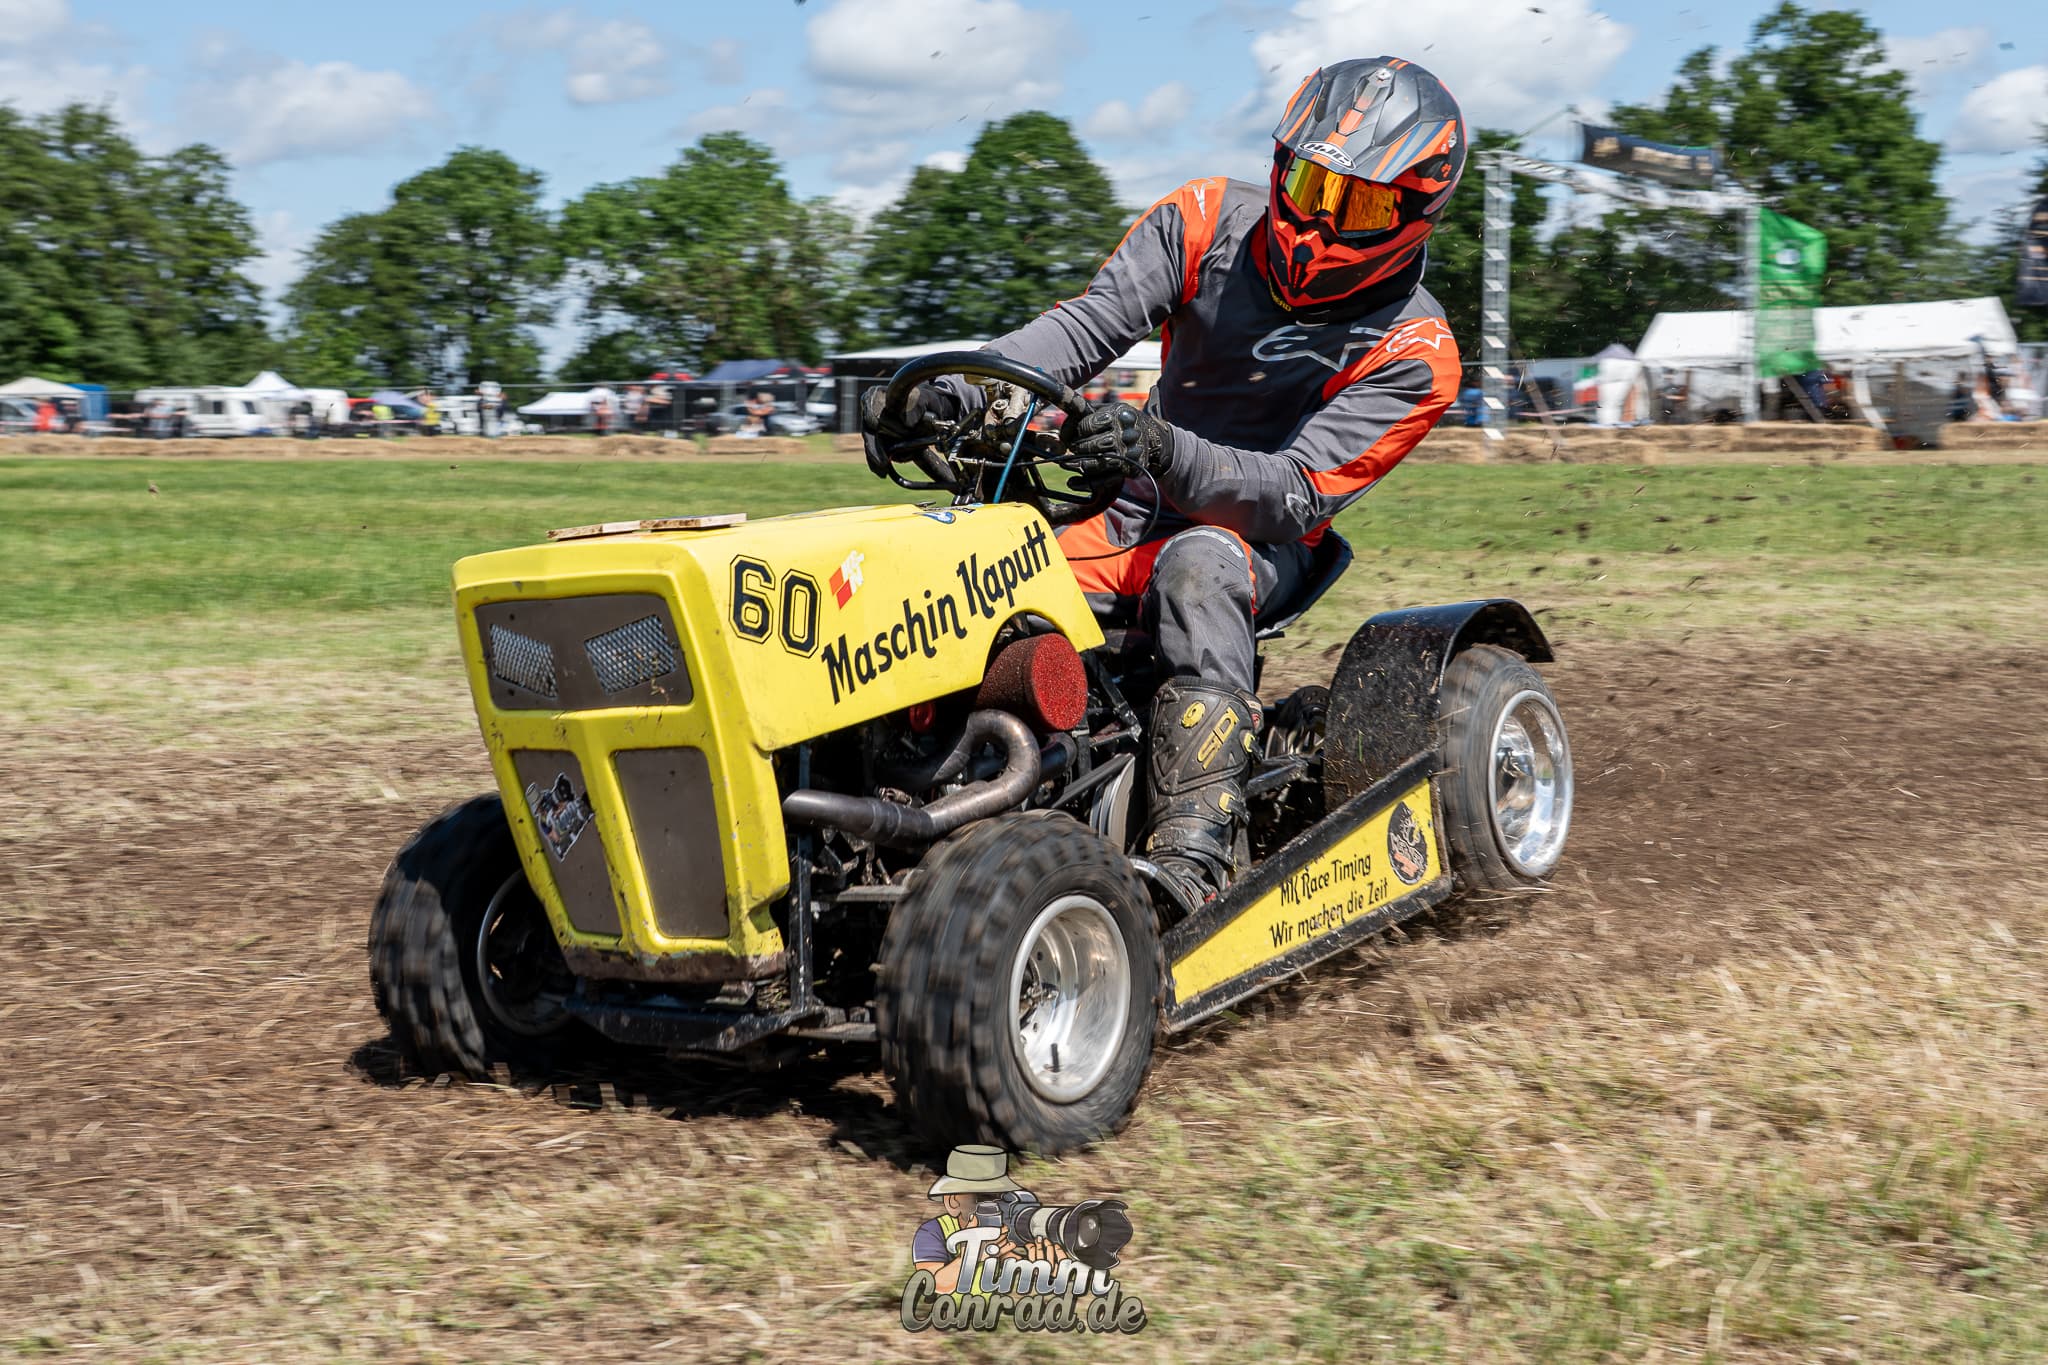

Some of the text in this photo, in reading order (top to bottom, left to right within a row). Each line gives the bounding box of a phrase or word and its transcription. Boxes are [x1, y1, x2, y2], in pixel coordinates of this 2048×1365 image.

[1302, 142, 1353, 168] HJC
[729, 554, 821, 658] 60
[821, 519, 1051, 706] Maschin Kaputt
[1269, 877, 1388, 948] Wir machen die Zeit
[1281, 854, 1371, 906] MK Race Timing
